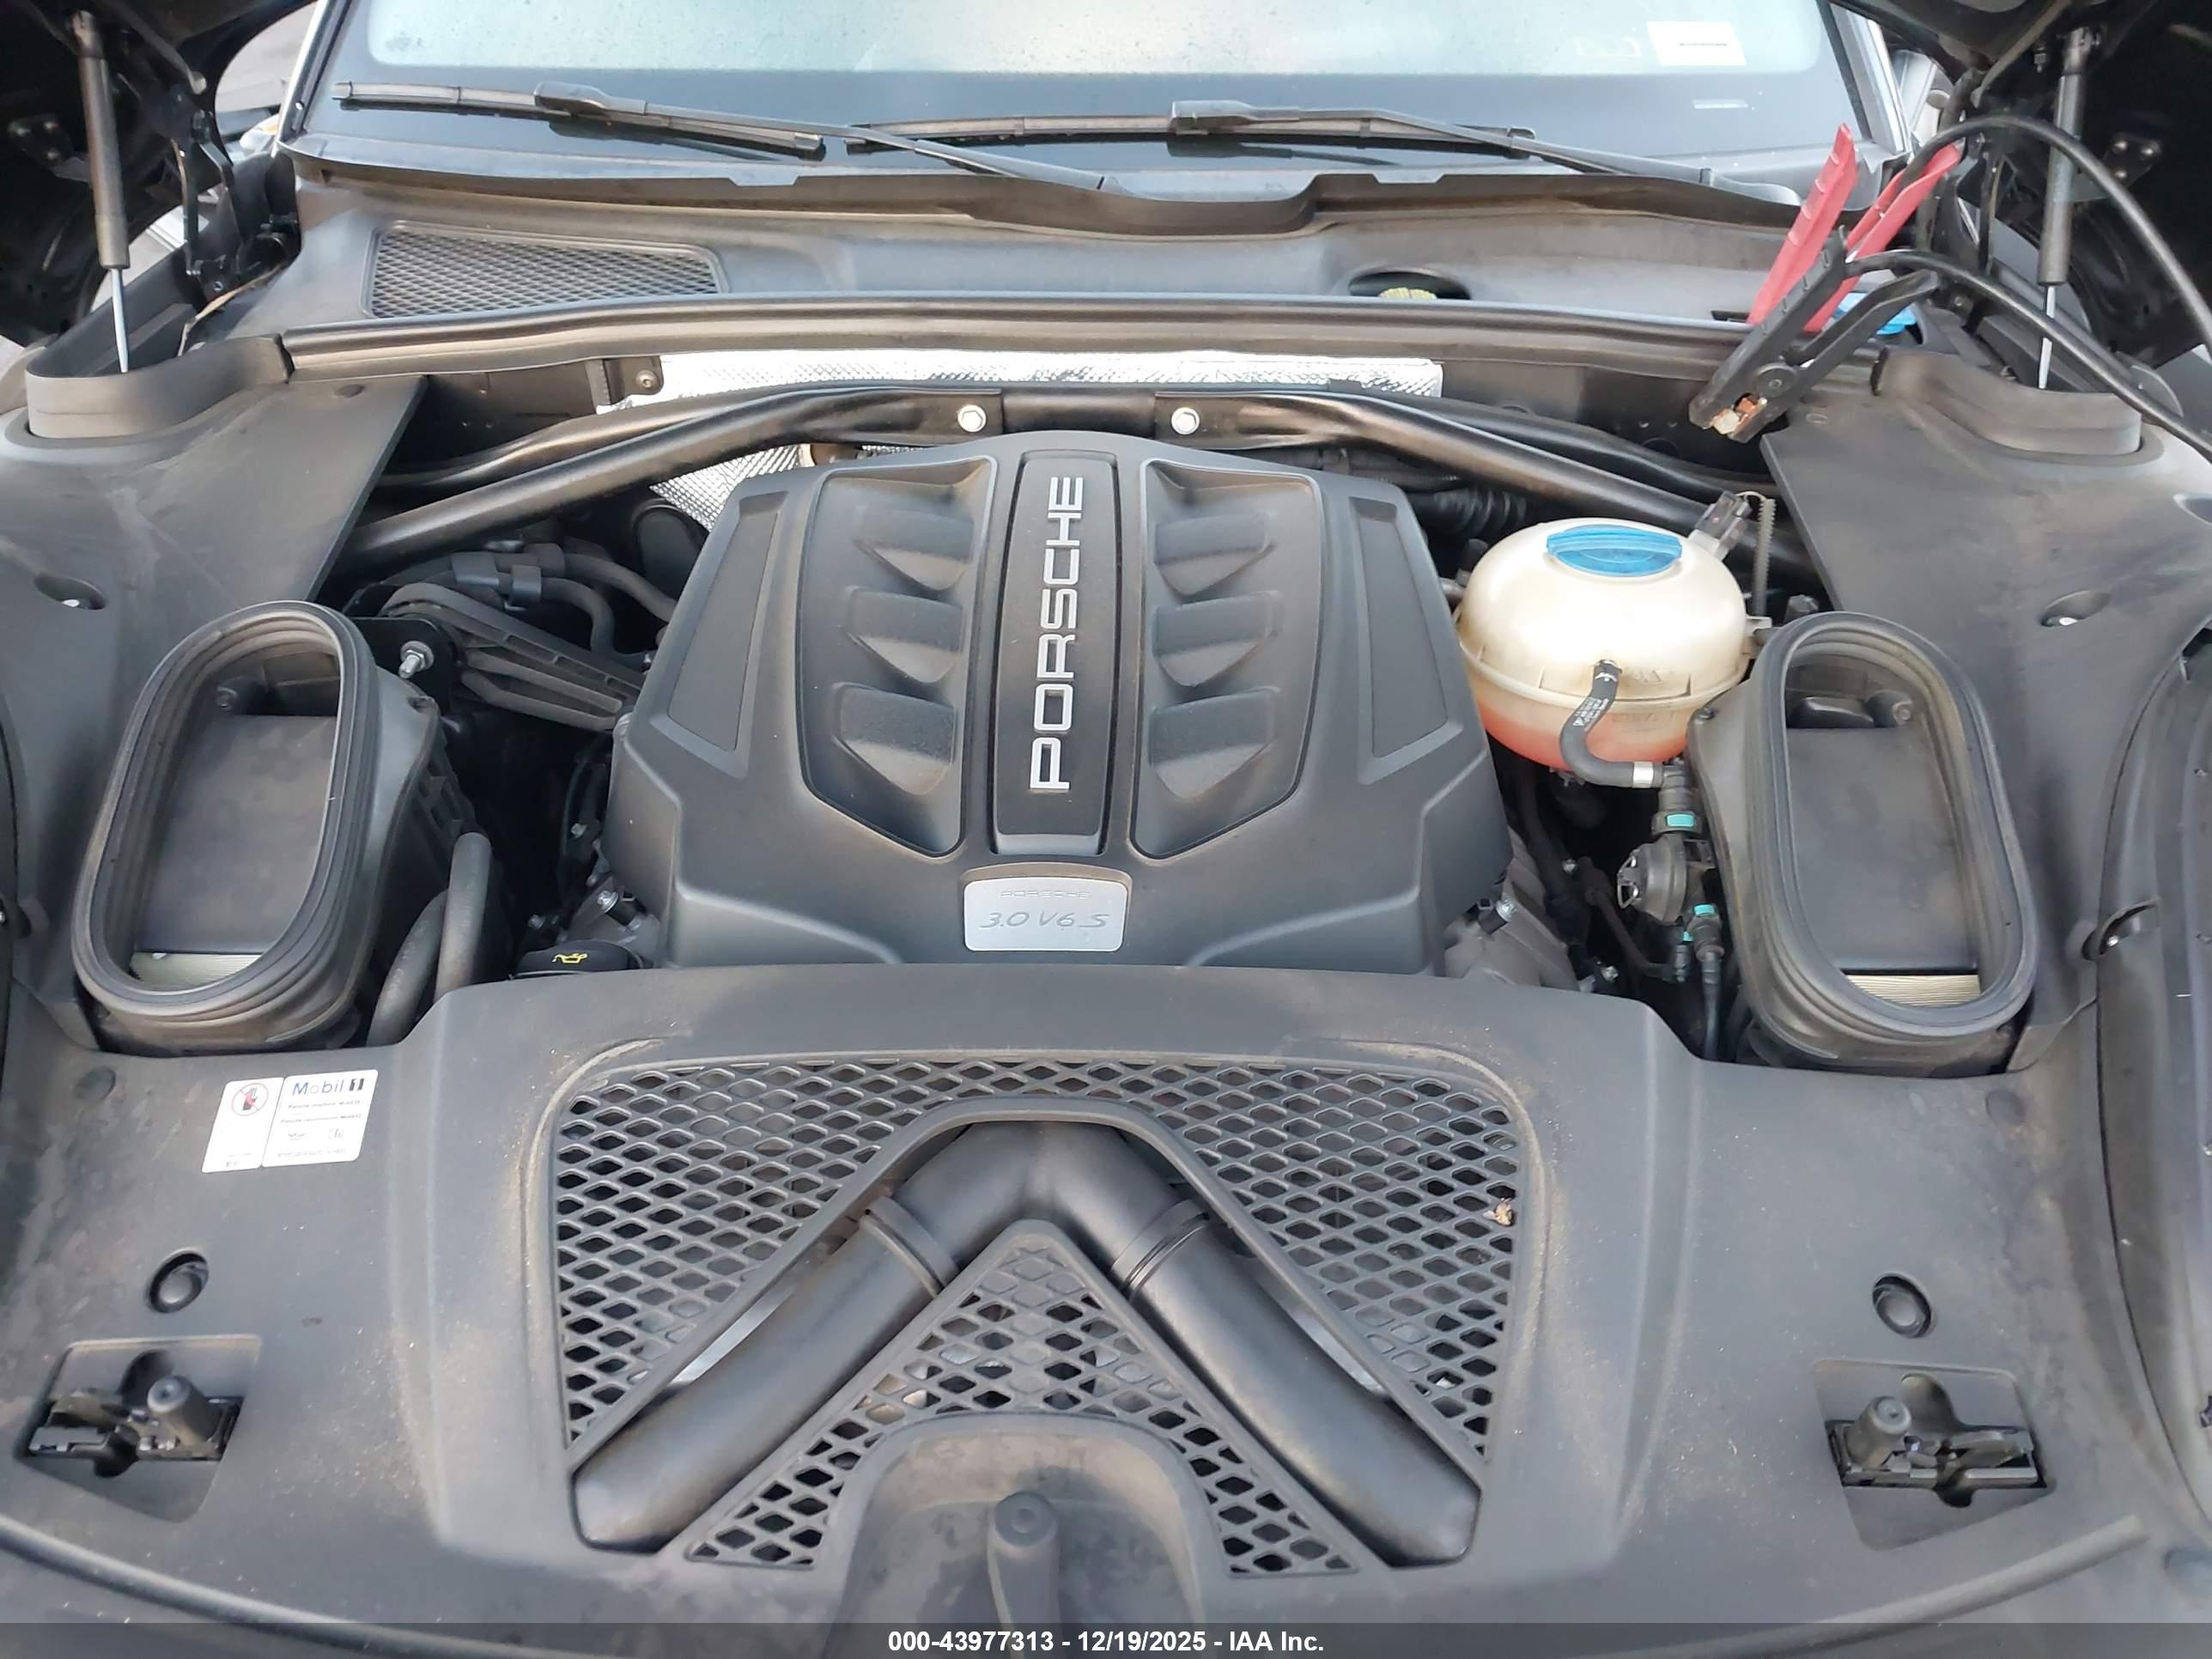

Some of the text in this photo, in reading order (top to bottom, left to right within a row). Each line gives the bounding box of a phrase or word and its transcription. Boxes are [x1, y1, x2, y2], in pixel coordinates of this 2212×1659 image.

[1030, 477, 1084, 790] PORSCHE
[979, 911, 1111, 928] 3.0 V6 S
[292, 1079, 344, 1096] Mobil
